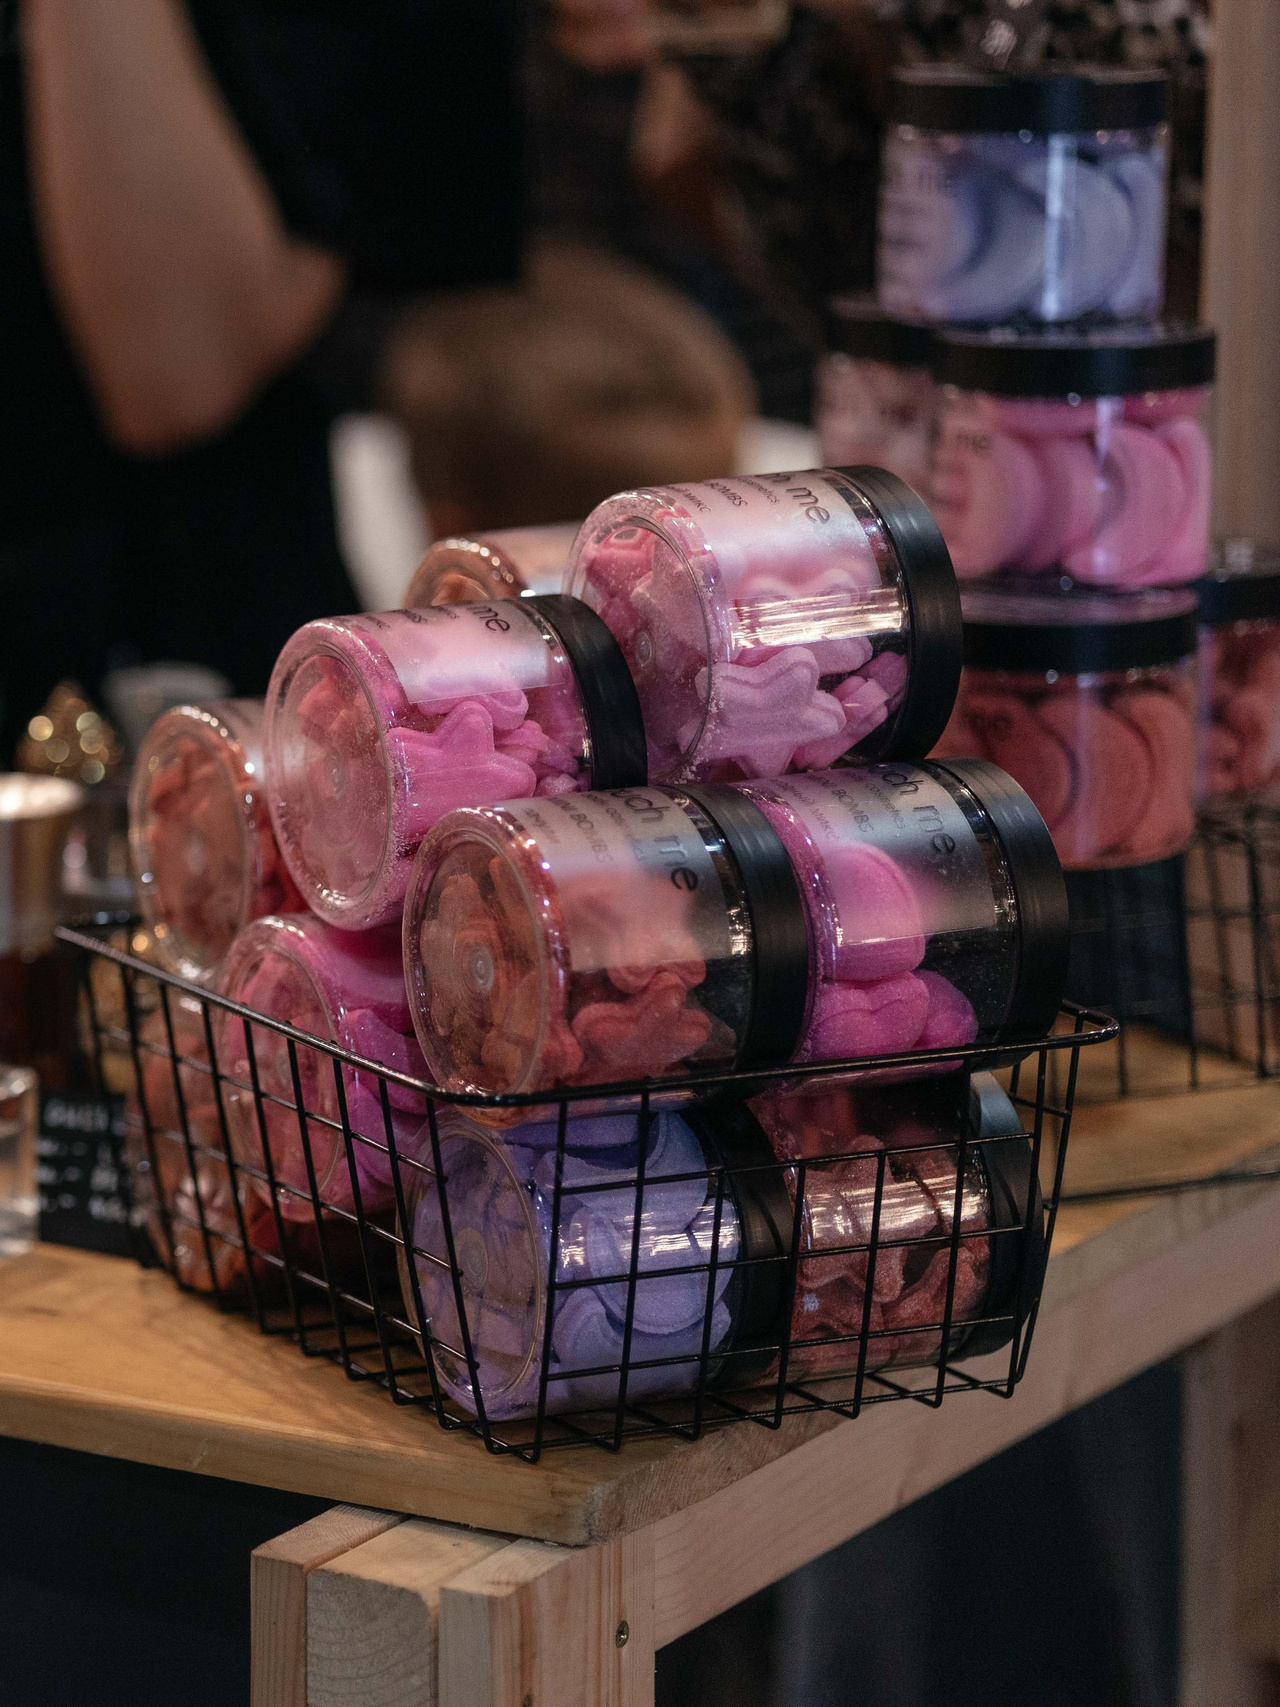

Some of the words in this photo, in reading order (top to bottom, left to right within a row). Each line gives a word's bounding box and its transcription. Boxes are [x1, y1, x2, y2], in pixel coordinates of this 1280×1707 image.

[785, 486, 831, 525] me
[466, 604, 510, 632] me
[831, 789, 875, 833] BOMBS
[913, 805, 956, 854] me
[654, 836, 699, 891] me
